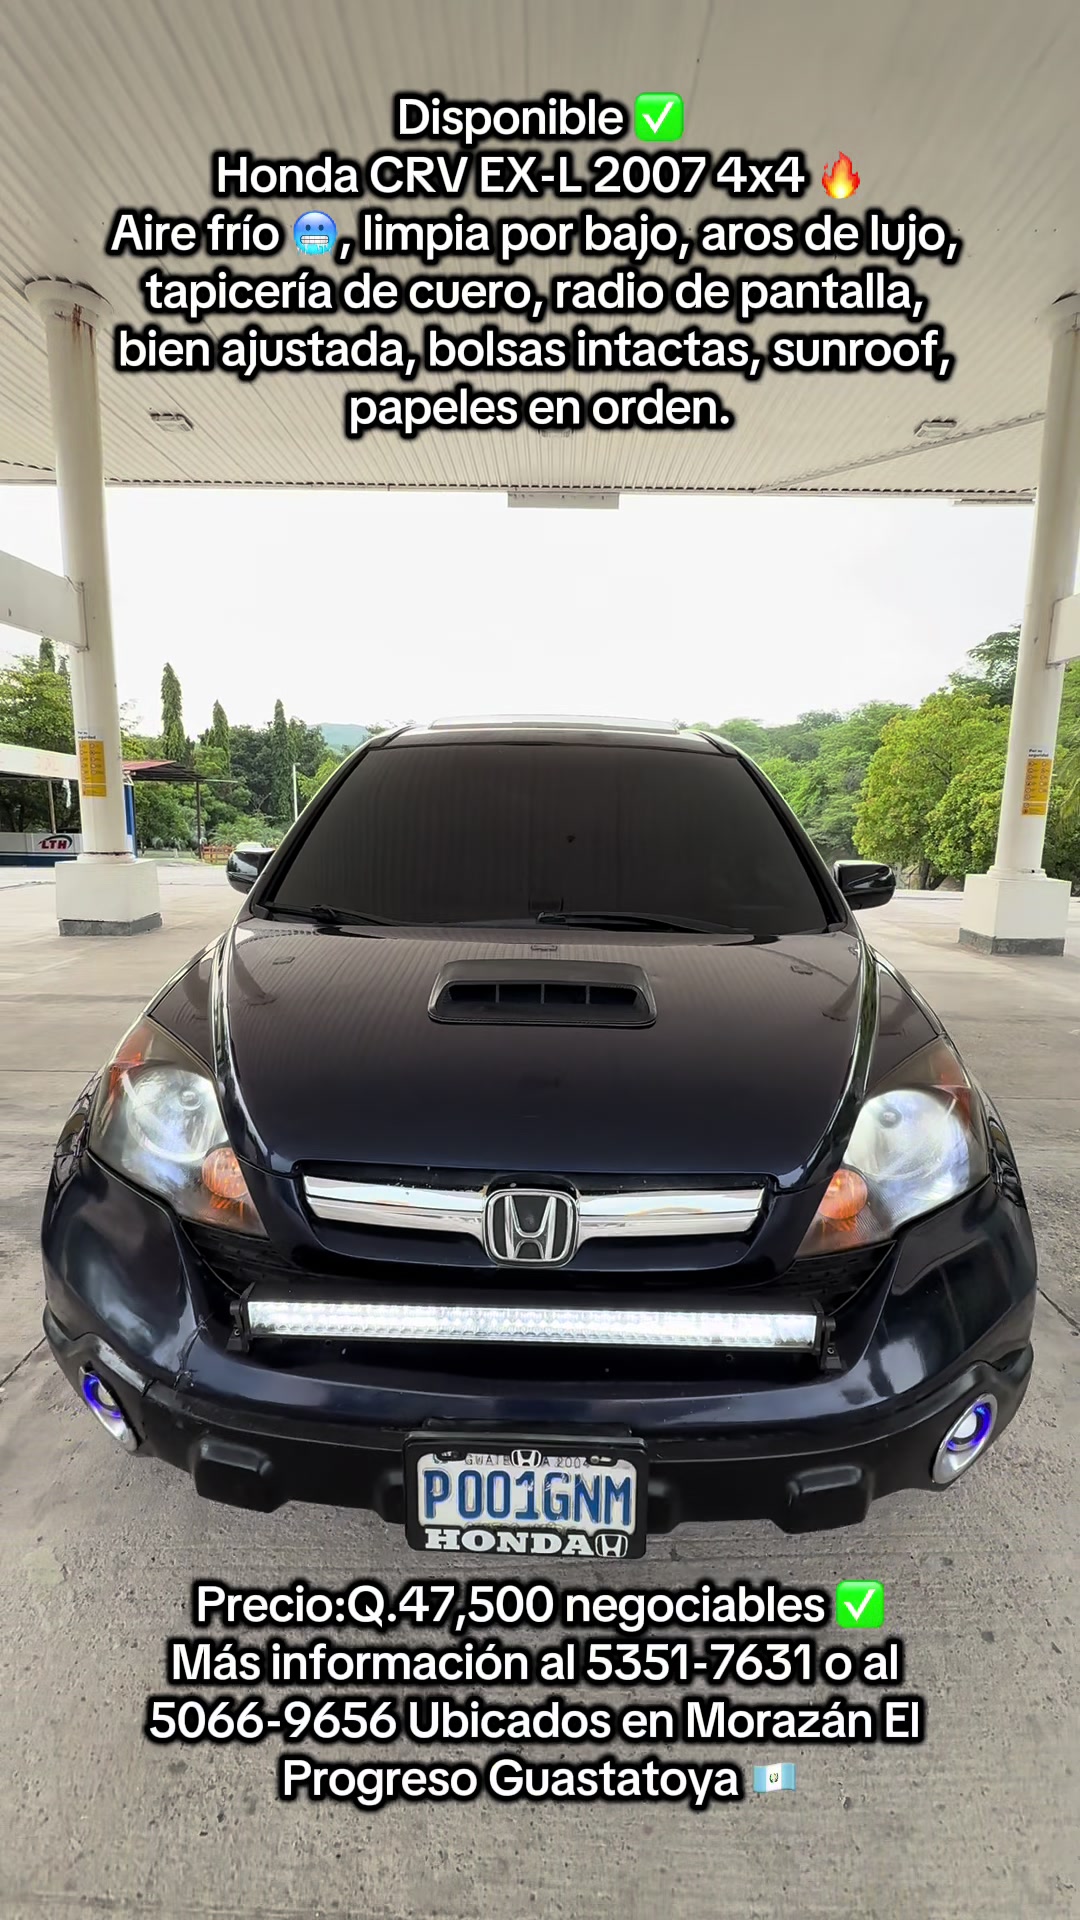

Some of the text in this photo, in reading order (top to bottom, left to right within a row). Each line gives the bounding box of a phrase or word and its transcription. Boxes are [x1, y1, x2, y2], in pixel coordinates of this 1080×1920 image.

[41, 840, 68, 849] LTH
[423, 1469, 632, 1526] P001GNM
[425, 1528, 595, 1557] HONDA
